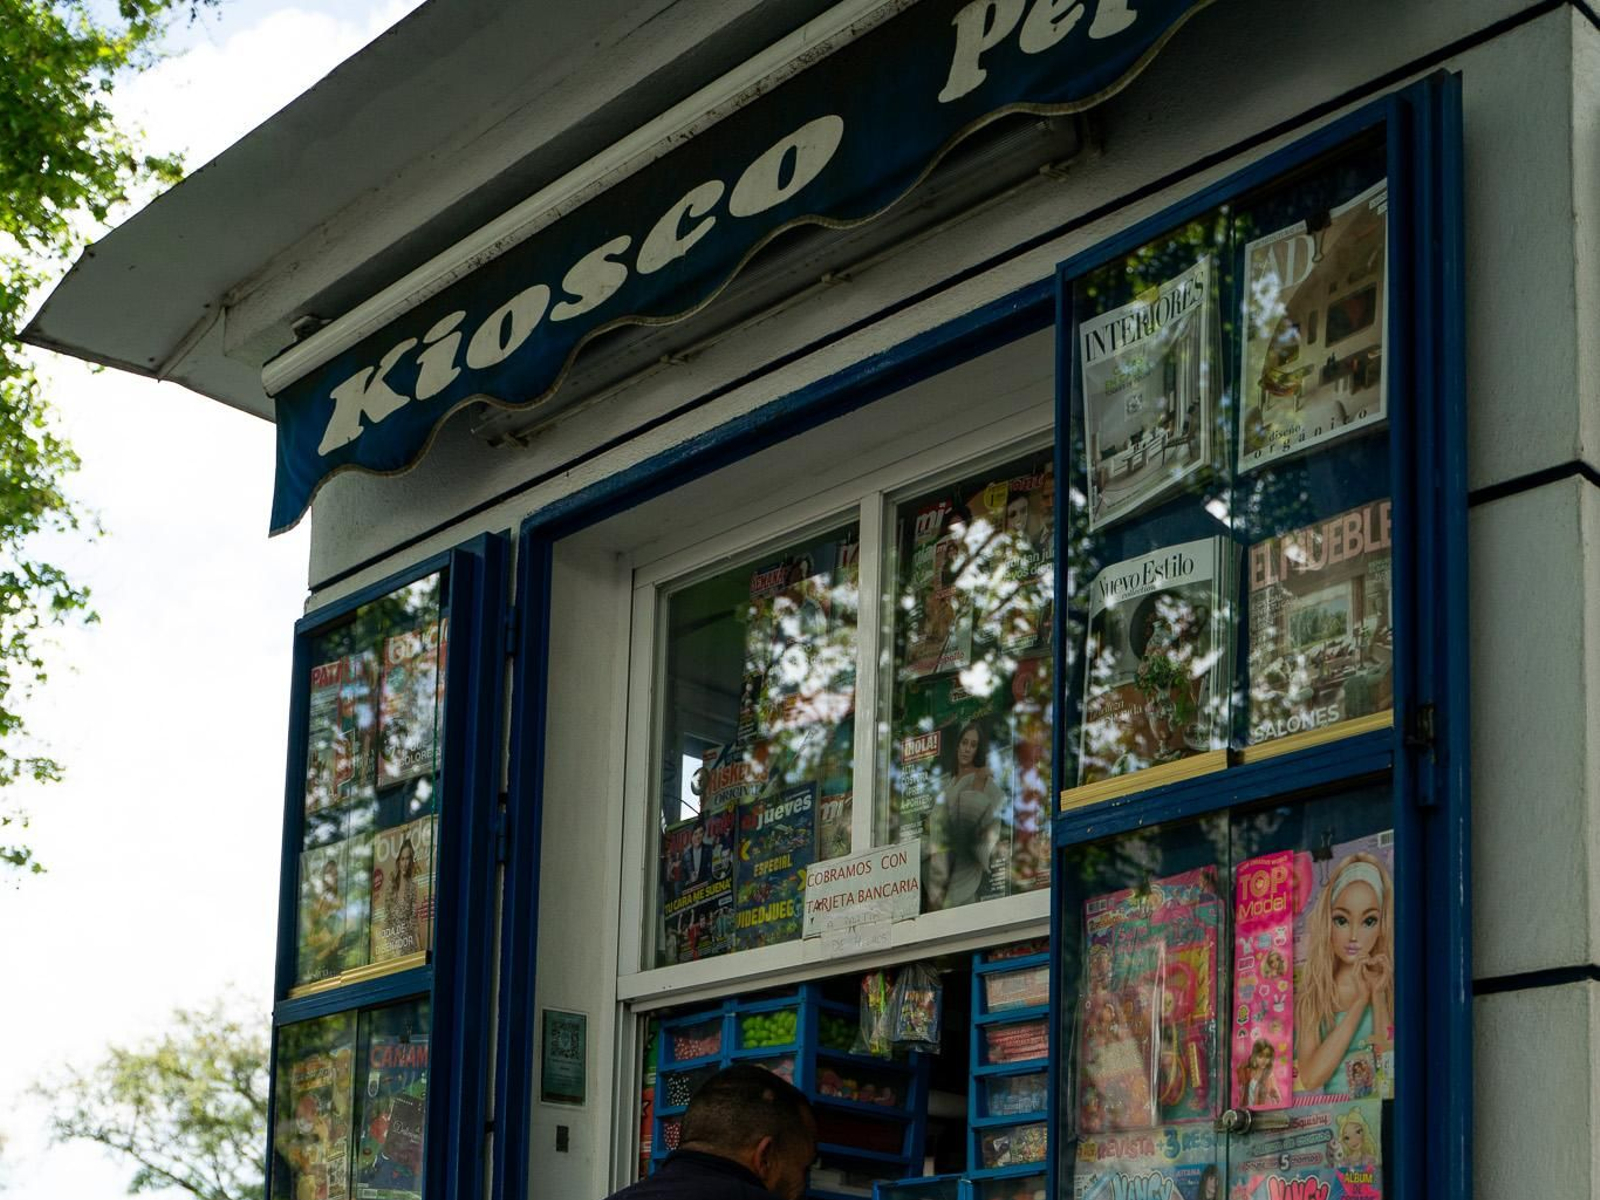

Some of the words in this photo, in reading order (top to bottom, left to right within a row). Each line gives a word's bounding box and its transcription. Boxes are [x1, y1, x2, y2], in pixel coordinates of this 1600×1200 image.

[318, 114, 845, 457] Kiosco
[1085, 271, 1205, 363] INTERIORES
[1142, 552, 1194, 586] Estilo
[1253, 703, 1341, 745] SALONES
[757, 794, 812, 831] jueves
[753, 852, 793, 877] ESPECIAL
[807, 860, 872, 888] COBRAMOS
[881, 851, 908, 870] CON
[807, 892, 855, 914] TARJETA
[857, 877, 919, 903] BANCARIA
[1240, 866, 1288, 901] TOP
[1280, 1153, 1290, 1171] 5
